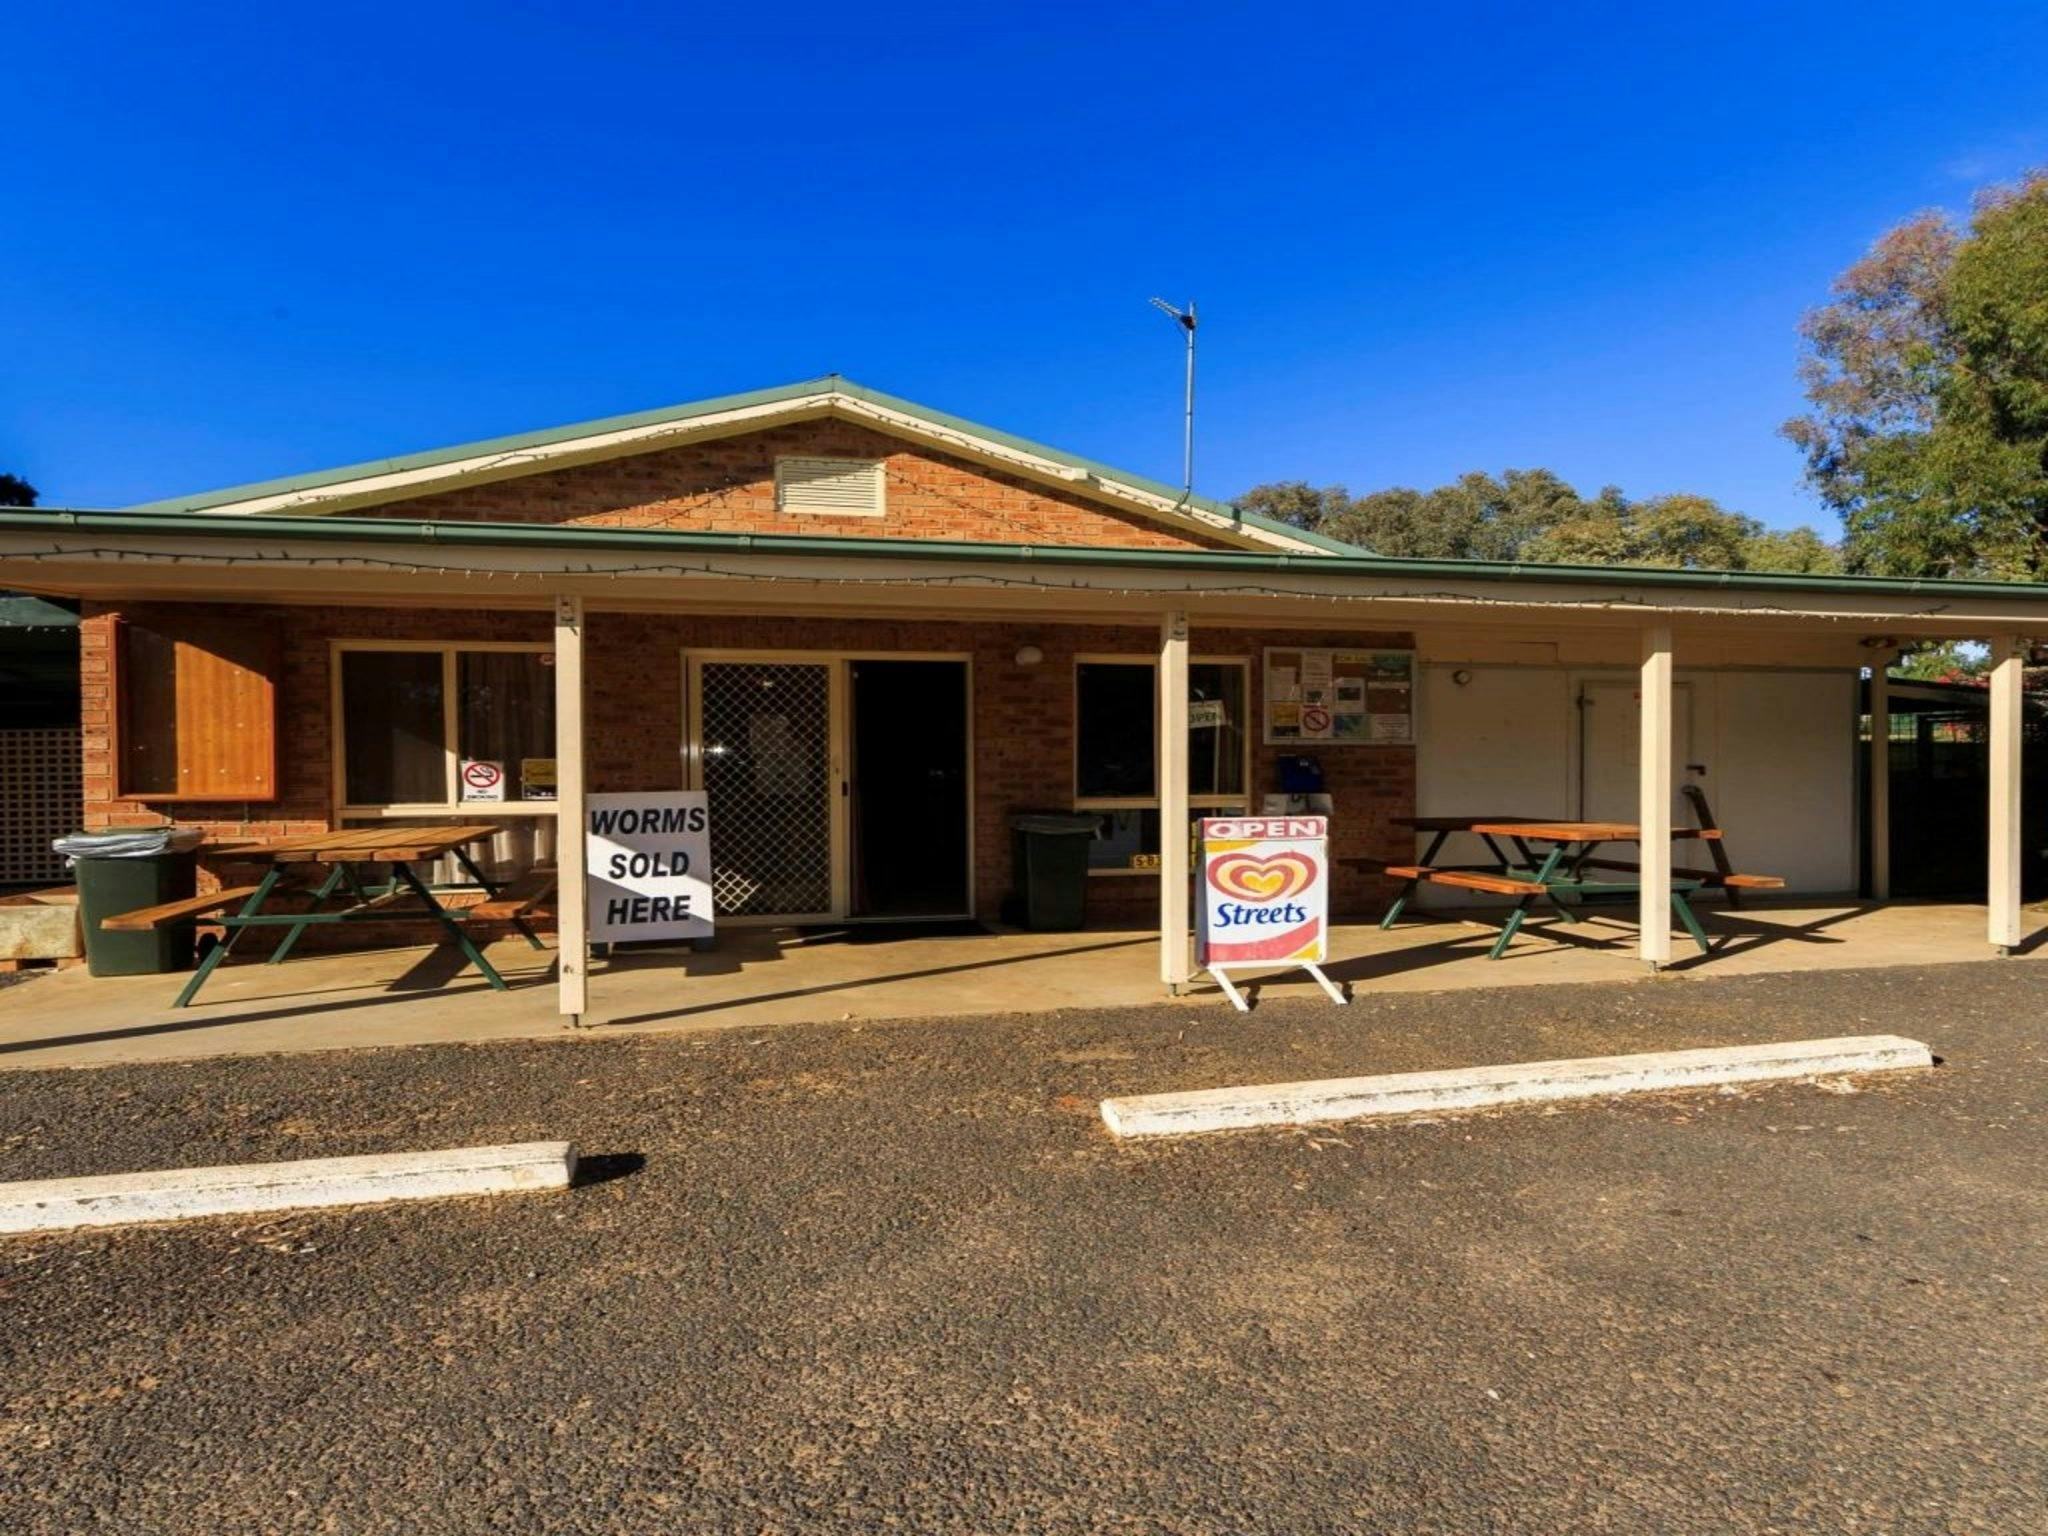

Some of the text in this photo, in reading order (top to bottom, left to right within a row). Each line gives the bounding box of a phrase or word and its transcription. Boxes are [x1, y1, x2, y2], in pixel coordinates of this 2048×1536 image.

[591, 807, 706, 835] WORMS
[1207, 821, 1317, 838] OPEN
[608, 851, 690, 879] SOLD
[606, 895, 692, 925] HERE
[1213, 902, 1308, 928] Streets
